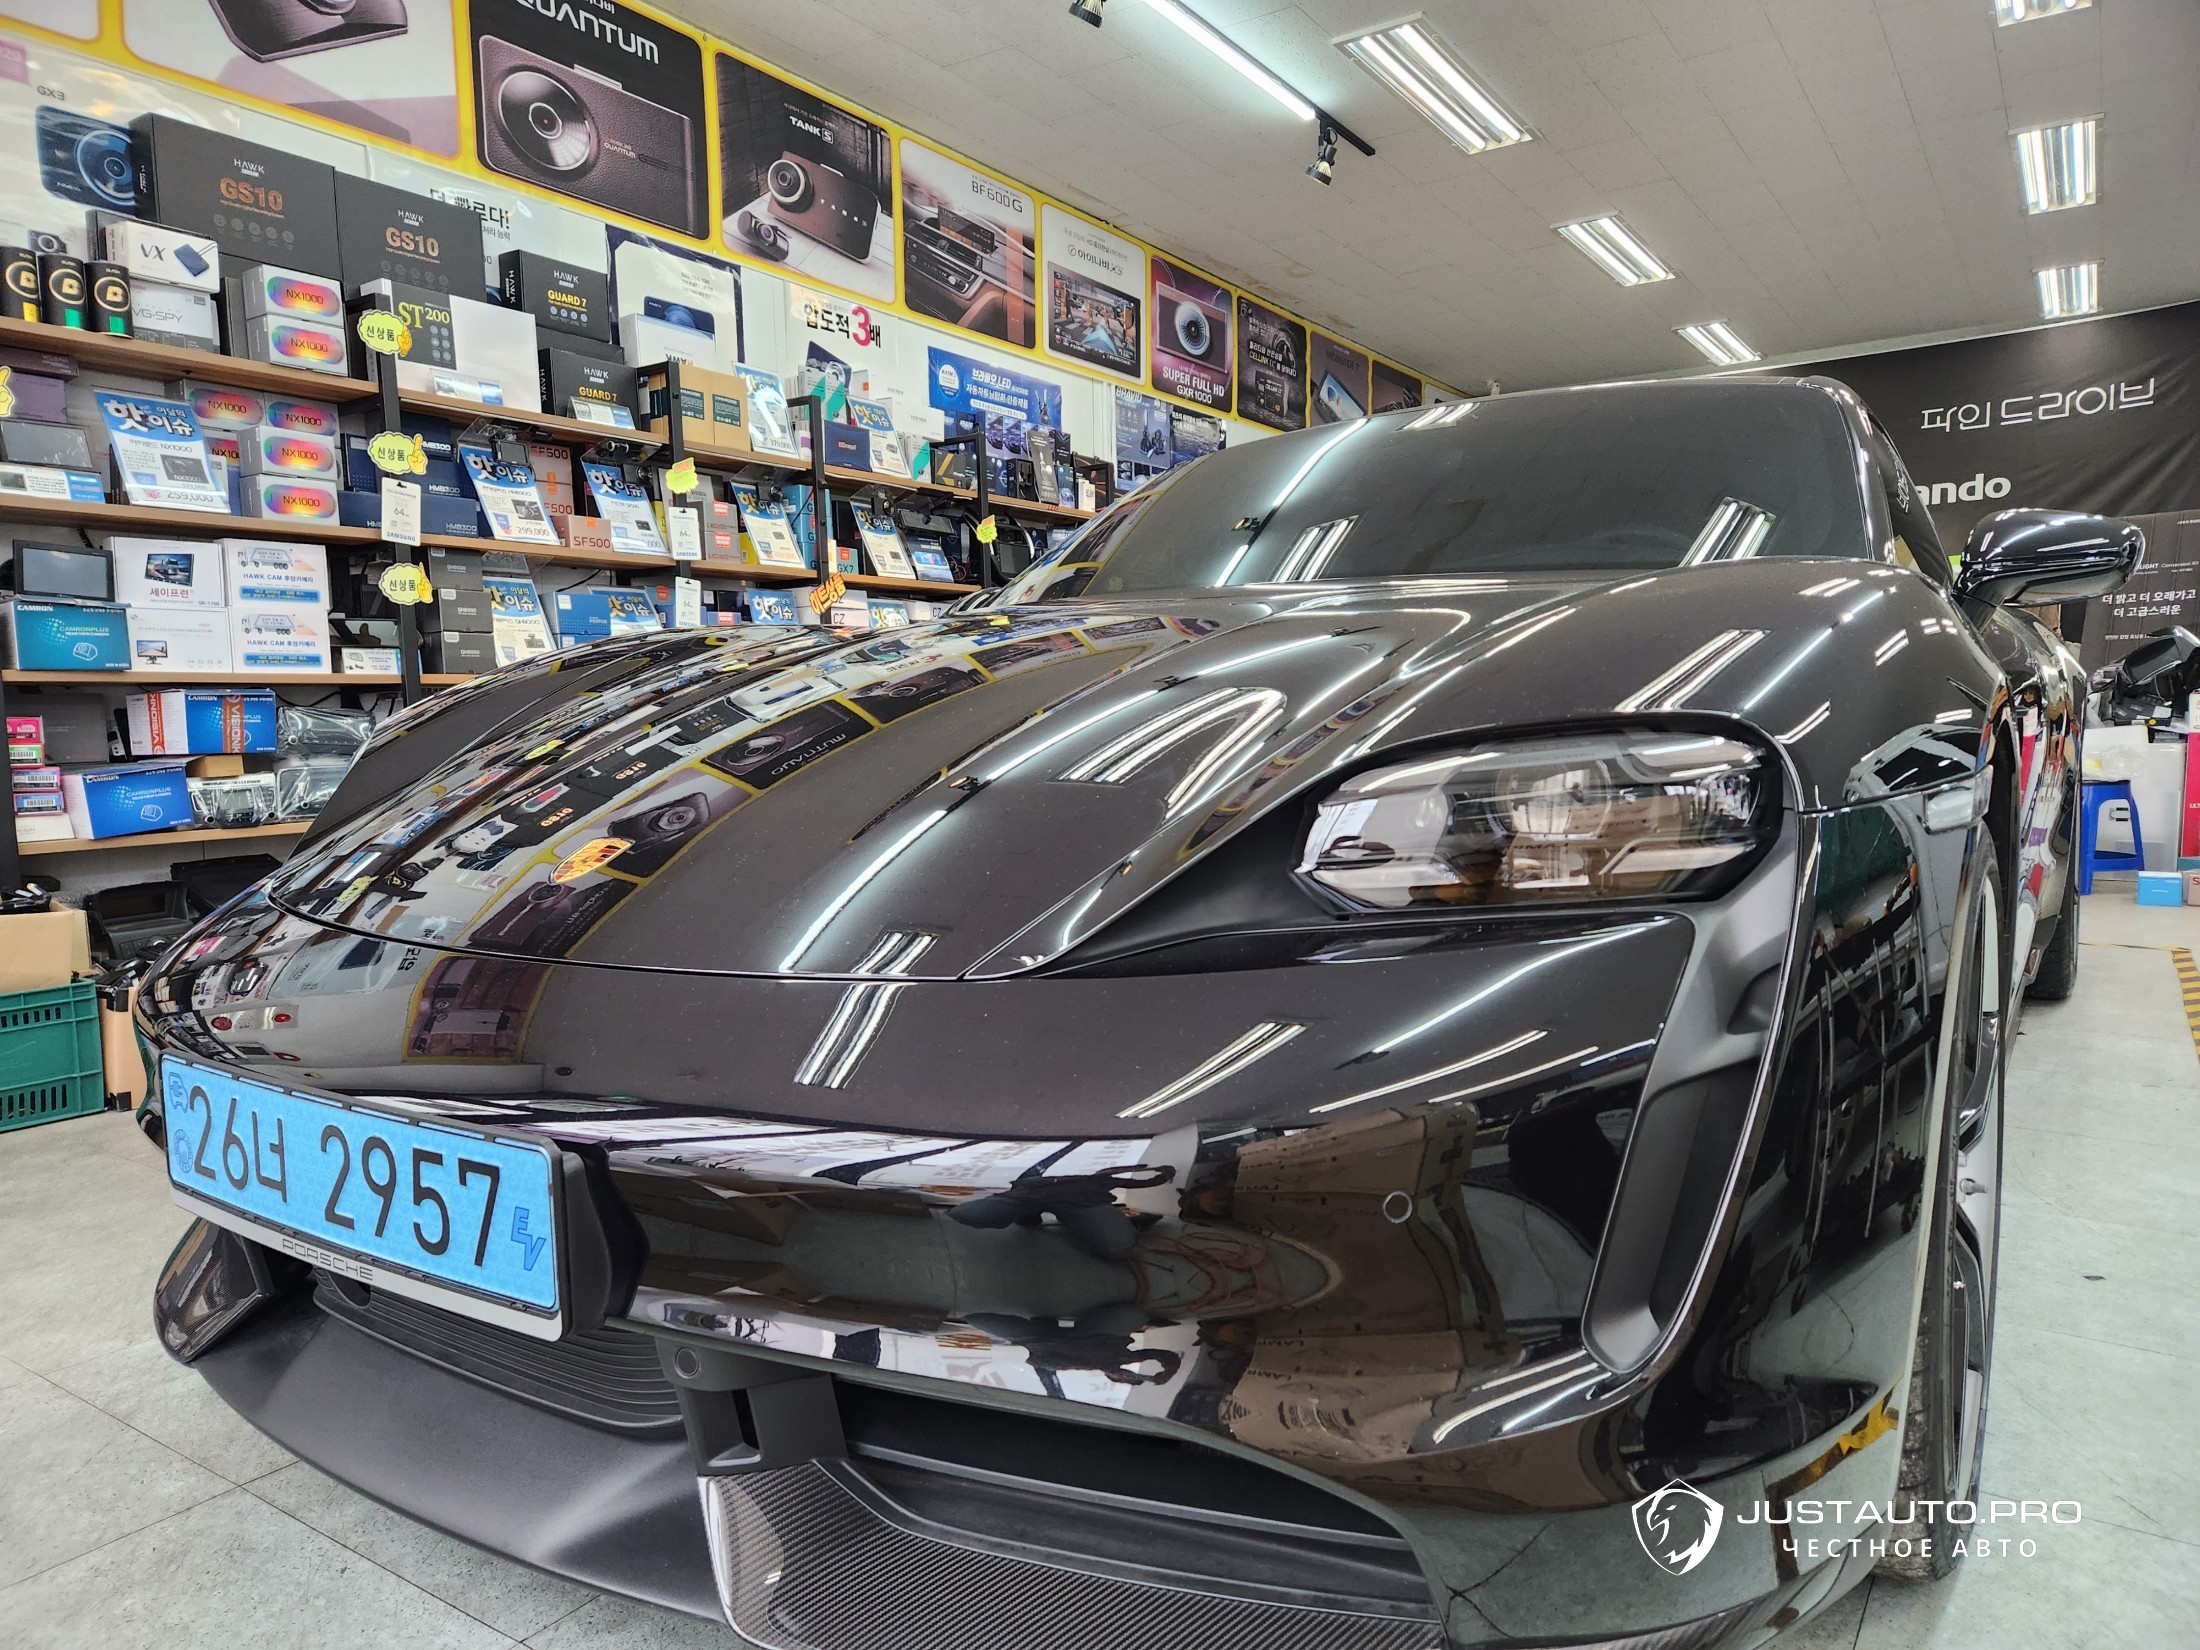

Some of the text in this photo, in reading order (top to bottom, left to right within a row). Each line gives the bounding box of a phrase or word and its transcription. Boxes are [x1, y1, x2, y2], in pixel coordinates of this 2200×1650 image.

[36, 85, 65, 101] GX3
[789, 115, 821, 137] TANK
[233, 158, 265, 174] HAWK
[220, 177, 283, 211] GS10
[397, 209, 424, 224] HAWK
[385, 226, 440, 258] GS10
[140, 243, 168, 262] VX
[1077, 249, 1109, 270] 아이나비
[553, 269, 580, 284] HAWK
[285, 288, 324, 305] NX1000
[547, 289, 587, 308] GUARD 7
[803, 303, 882, 348] 압도적 3배
[365, 325, 395, 342] 신상품
[290, 337, 329, 353] NX1000
[583, 366, 609, 380] HAWK
[1162, 366, 1191, 386] SUPER
[1192, 376, 1212, 393] FULL
[1213, 383, 1225, 397] HD
[578, 386, 617, 402] GUARD 7
[155, 405, 186, 418] 이달의
[207, 400, 247, 415] NX1000
[285, 413, 322, 427] NX1000
[281, 447, 319, 461] NX1000
[377, 447, 406, 463] 신상품
[530, 445, 568, 460] SF500
[167, 491, 214, 503] 259,000
[282, 495, 321, 507] NX1000
[386, 531, 416, 542] SAMSUNG
[516, 526, 550, 537] 299,000
[573, 535, 611, 550] SF500
[837, 563, 854, 574] GX7
[243, 572, 314, 583] HAWK CAM 후방카메라
[389, 578, 416, 592] 신상품
[150, 587, 190, 599] 세이프런
[809, 573, 848, 616] 히트상품
[2102, 589, 2197, 605] 더 밝고 더 오래가고
[932, 607, 942, 618] CZ
[2113, 604, 2182, 618] 더 고급스러운
[833, 613, 846, 625] CZ
[269, 639, 285, 647] CAM
[286, 639, 316, 648] 후방카메라
[188, 1085, 501, 1268] 26너 2957
[511, 1206, 548, 1272] EV
[282, 1237, 374, 1282] PORSCHE
